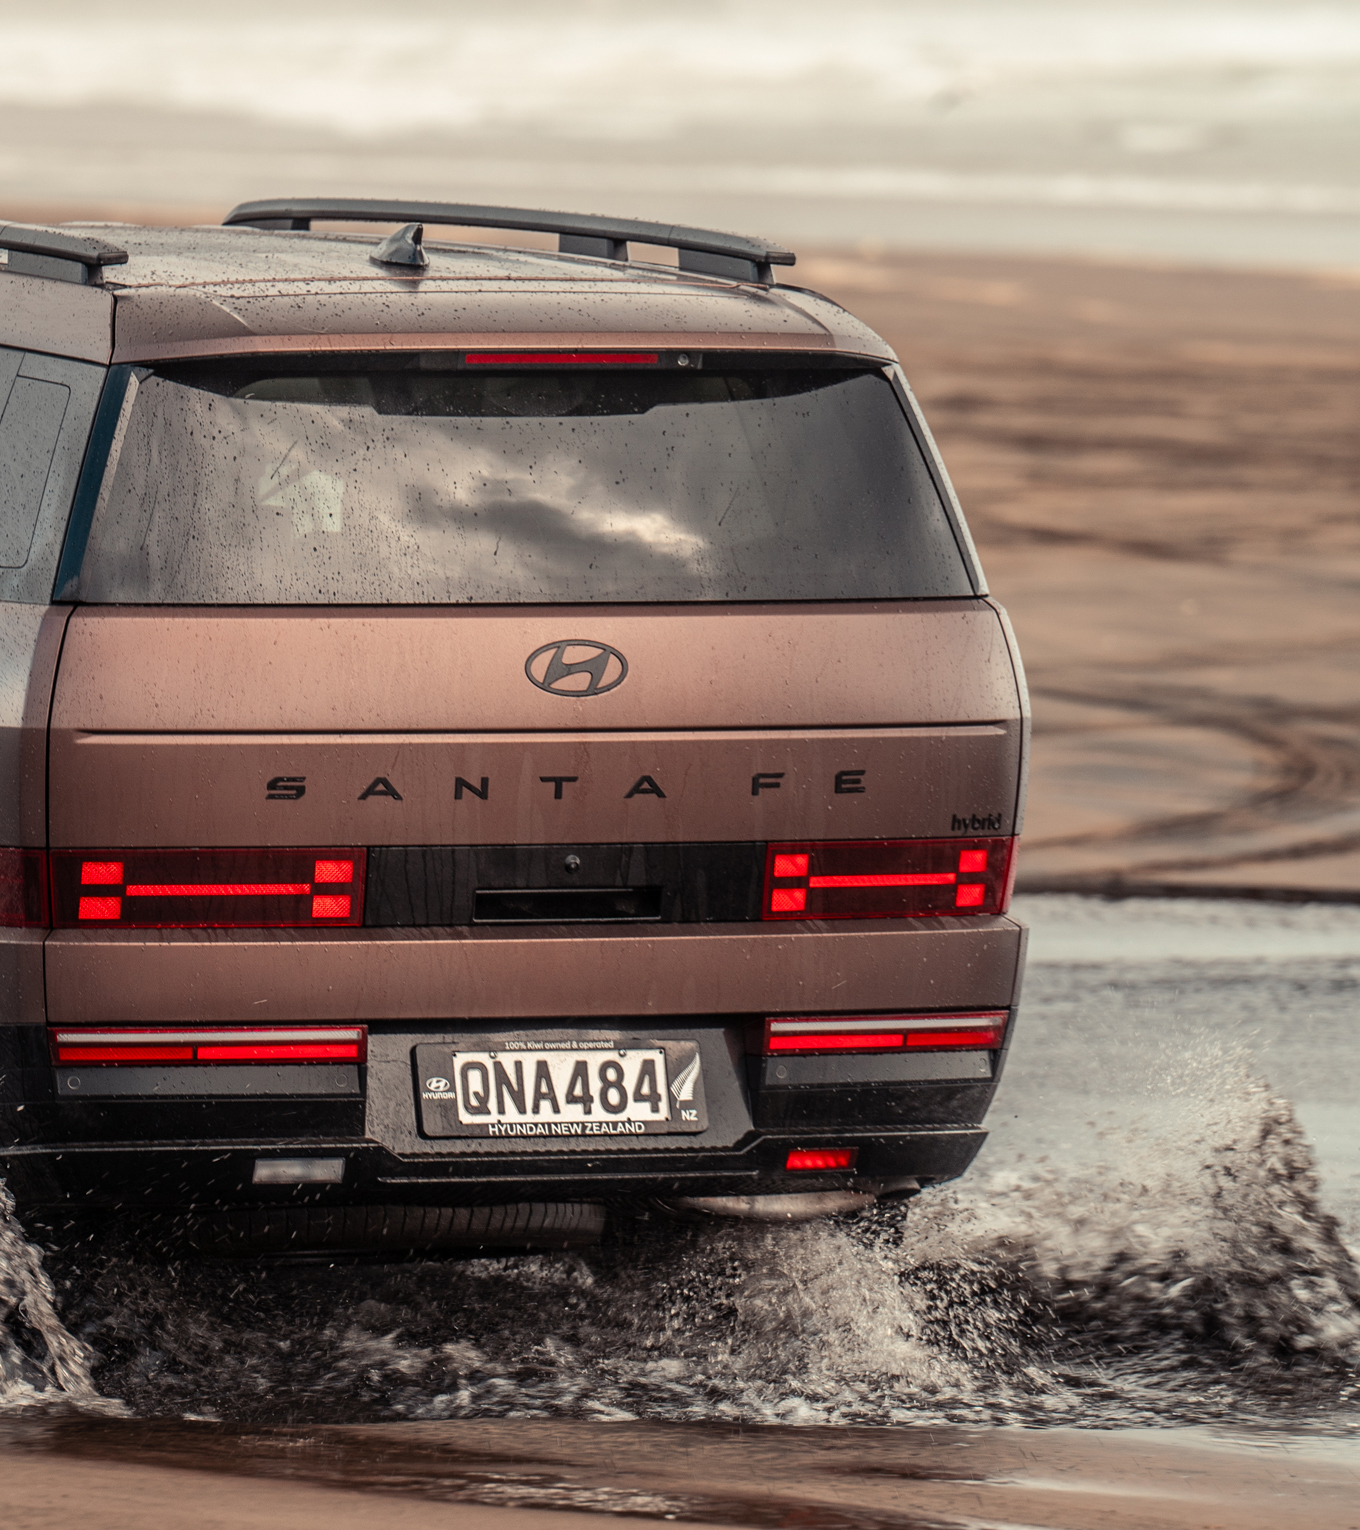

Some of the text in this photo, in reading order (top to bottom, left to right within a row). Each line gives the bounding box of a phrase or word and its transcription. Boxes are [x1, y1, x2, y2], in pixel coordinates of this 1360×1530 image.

[265, 770, 866, 801] SANTA FE
[951, 813, 1002, 834] hybrid
[505, 1040, 614, 1051] 100% Kiwi owned & operated
[460, 1058, 662, 1116] QNA484
[422, 1091, 456, 1100] HYUNDAI
[681, 1109, 698, 1121] NZ
[489, 1121, 645, 1136] HYUNDAI NEW ZEALAND
